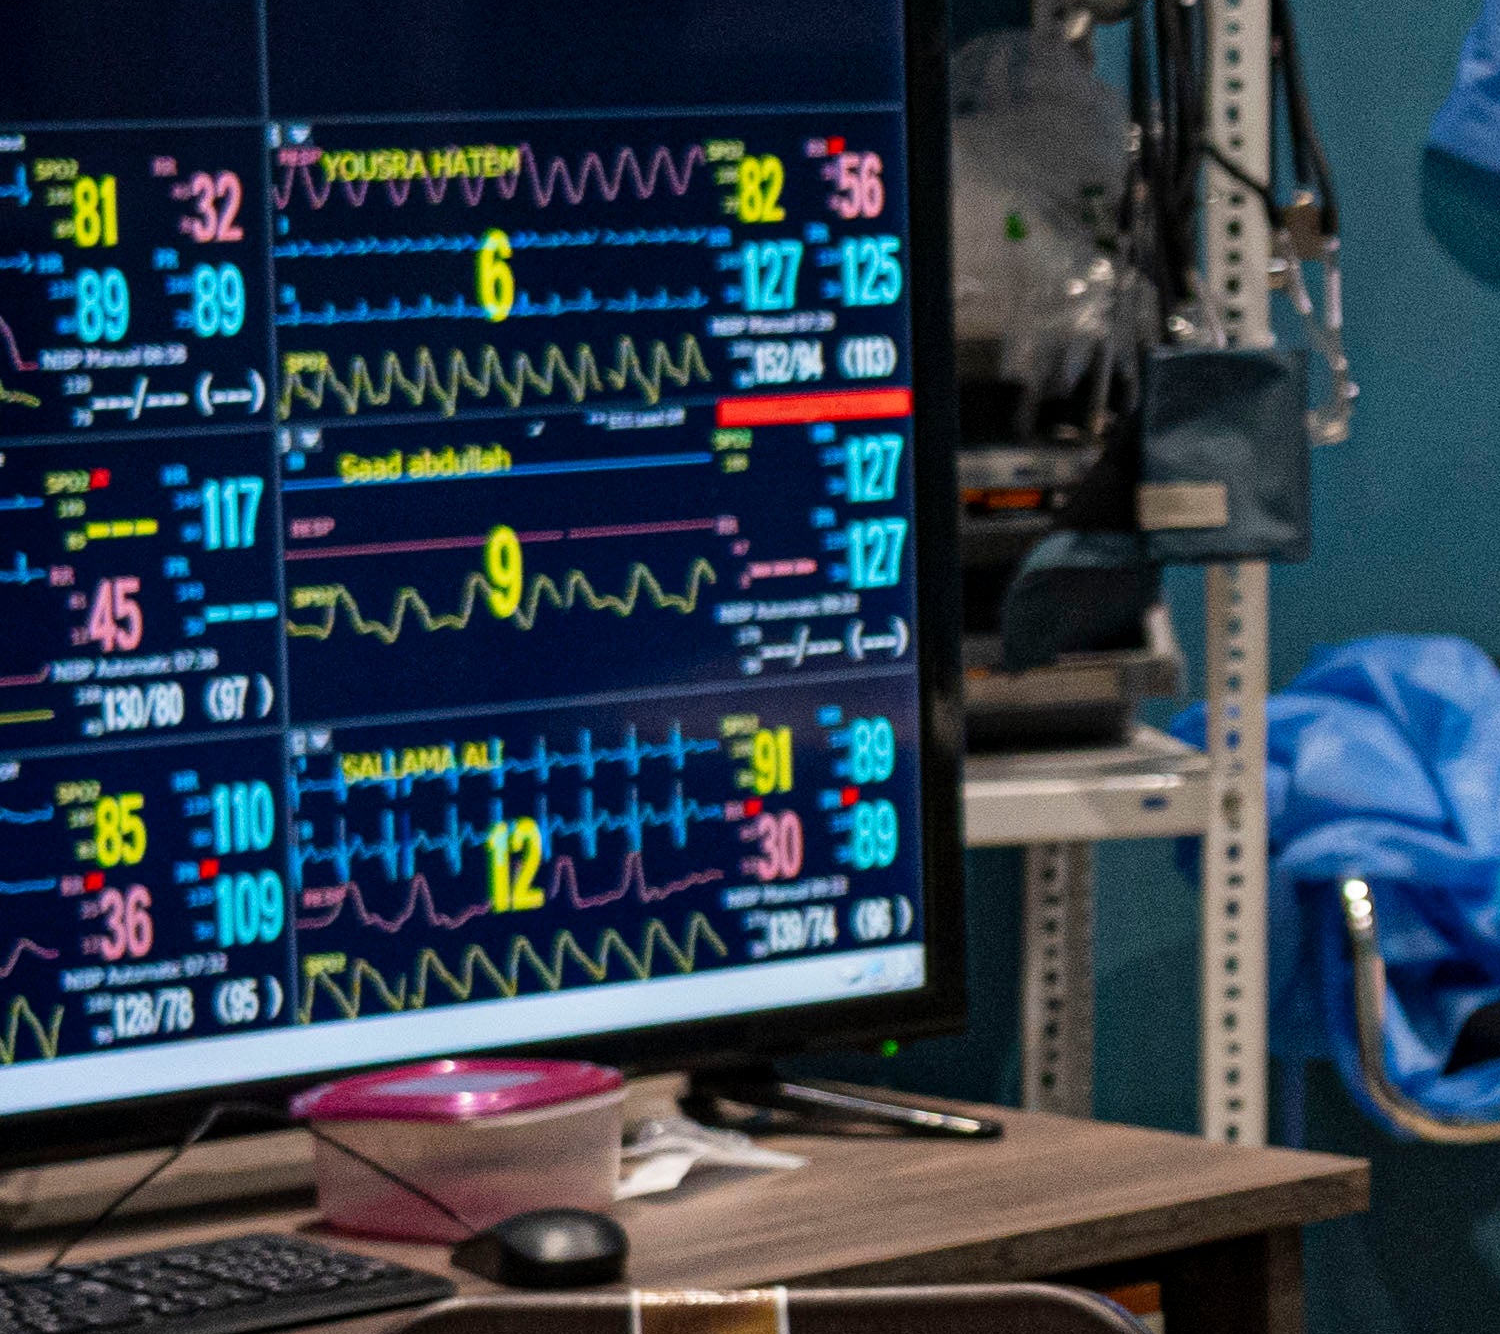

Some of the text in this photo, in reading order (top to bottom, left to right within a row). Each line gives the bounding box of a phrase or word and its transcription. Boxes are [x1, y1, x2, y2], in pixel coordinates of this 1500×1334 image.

[322, 144, 521, 182] YOUSRA HATEM
[737, 154, 786, 224] 82
[838, 151, 886, 220] 56
[74, 175, 118, 247] 81
[192, 170, 245, 243] 32
[76, 267, 130, 342] 89
[194, 262, 245, 337] 89
[475, 227, 515, 323] 6
[742, 238, 803, 312] 127
[842, 233, 902, 307] 125
[338, 443, 512, 484] Saad abdullah
[844, 432, 904, 503] 127
[202, 476, 264, 551] 117
[483, 524, 523, 619] 9
[845, 517, 908, 590] 127
[88, 575, 143, 653] 45
[102, 681, 185, 733] 130/80
[752, 725, 794, 795] 91
[850, 716, 896, 784] 89
[96, 792, 147, 868] 85
[211, 779, 275, 856] 110
[757, 810, 804, 882] 30
[851, 798, 898, 870] 89
[487, 817, 546, 913] 12
[100, 883, 154, 962] 36
[215, 869, 285, 948] 109
[113, 985, 194, 1039] 128/78
